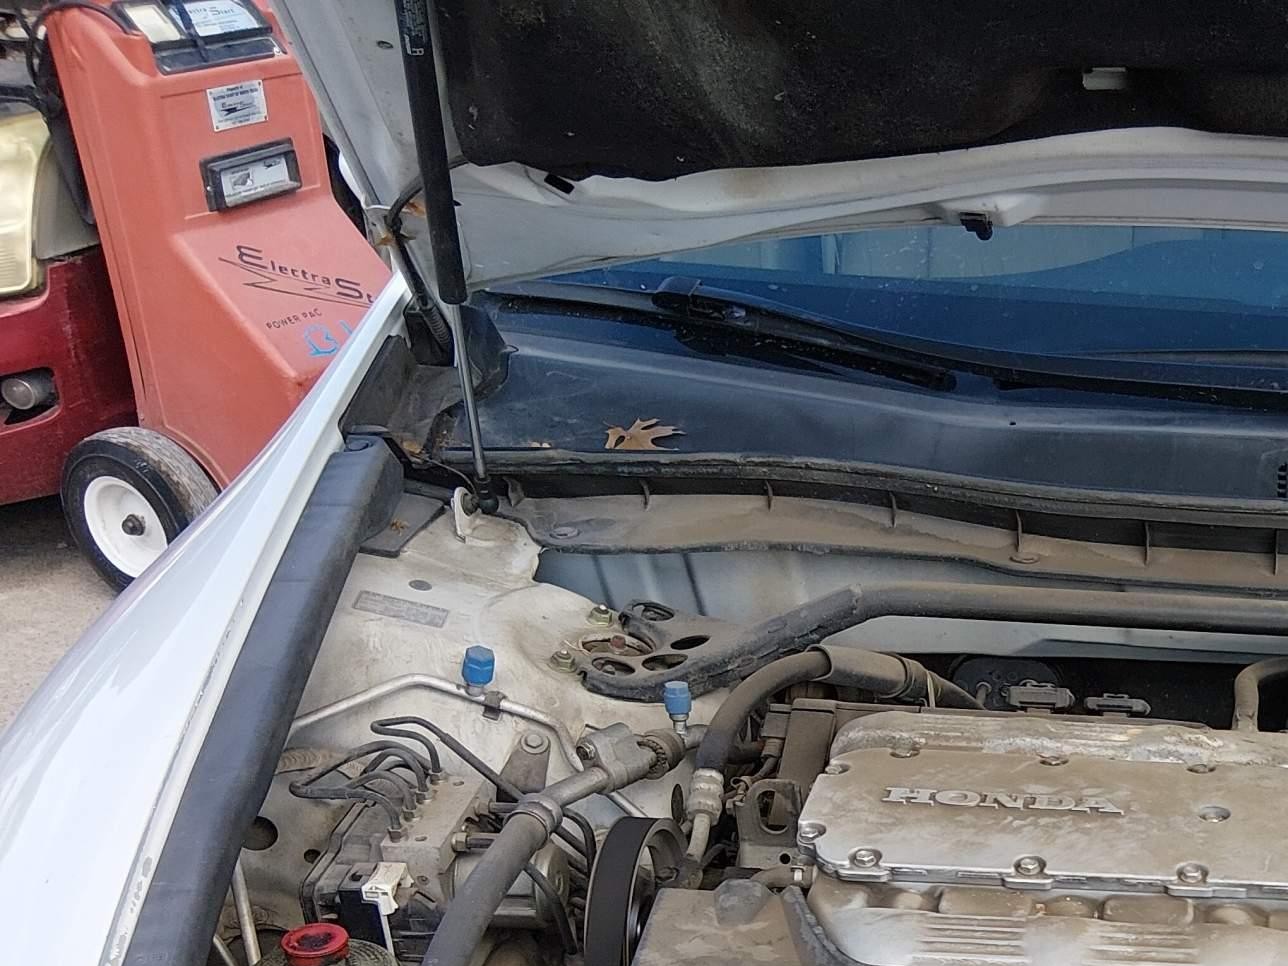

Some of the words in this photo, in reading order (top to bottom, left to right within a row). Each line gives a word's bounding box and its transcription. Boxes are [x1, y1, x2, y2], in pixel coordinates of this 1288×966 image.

[266, 314, 300, 329] POWER
[301, 308, 322, 319] PAC
[882, 787, 1124, 815] HONDA
